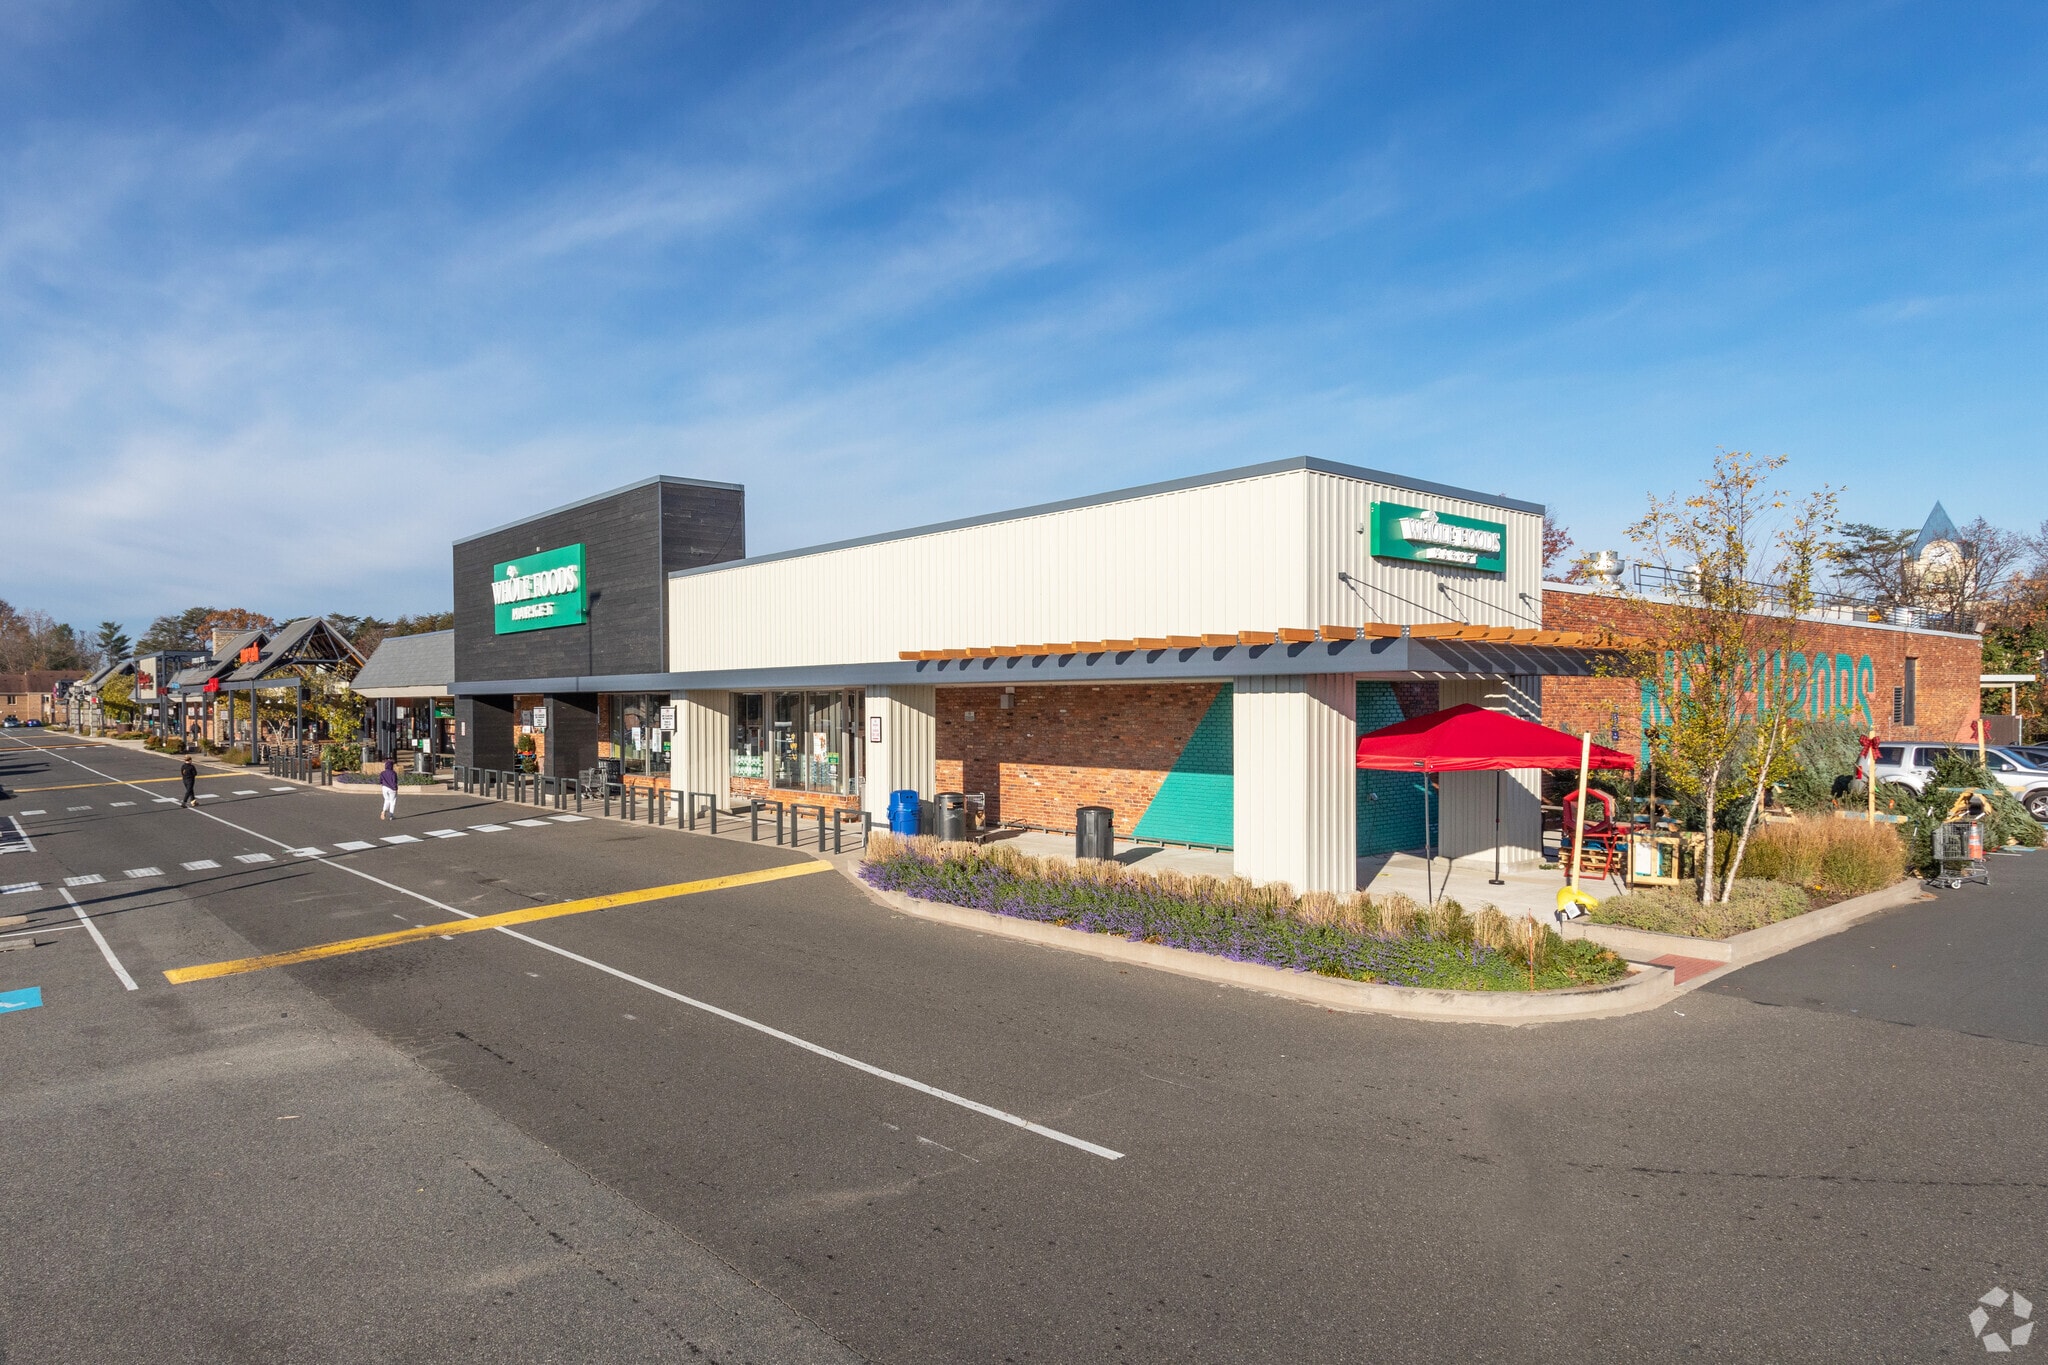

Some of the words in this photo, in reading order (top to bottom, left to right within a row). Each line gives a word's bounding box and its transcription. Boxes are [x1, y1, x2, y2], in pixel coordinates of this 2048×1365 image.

[1399, 518, 1457, 545] WHOLE
[1457, 526, 1500, 552] FOODS
[491, 574, 533, 605] WHOLE
[533, 565, 578, 599] FOODS
[512, 602, 555, 620] MARKET
